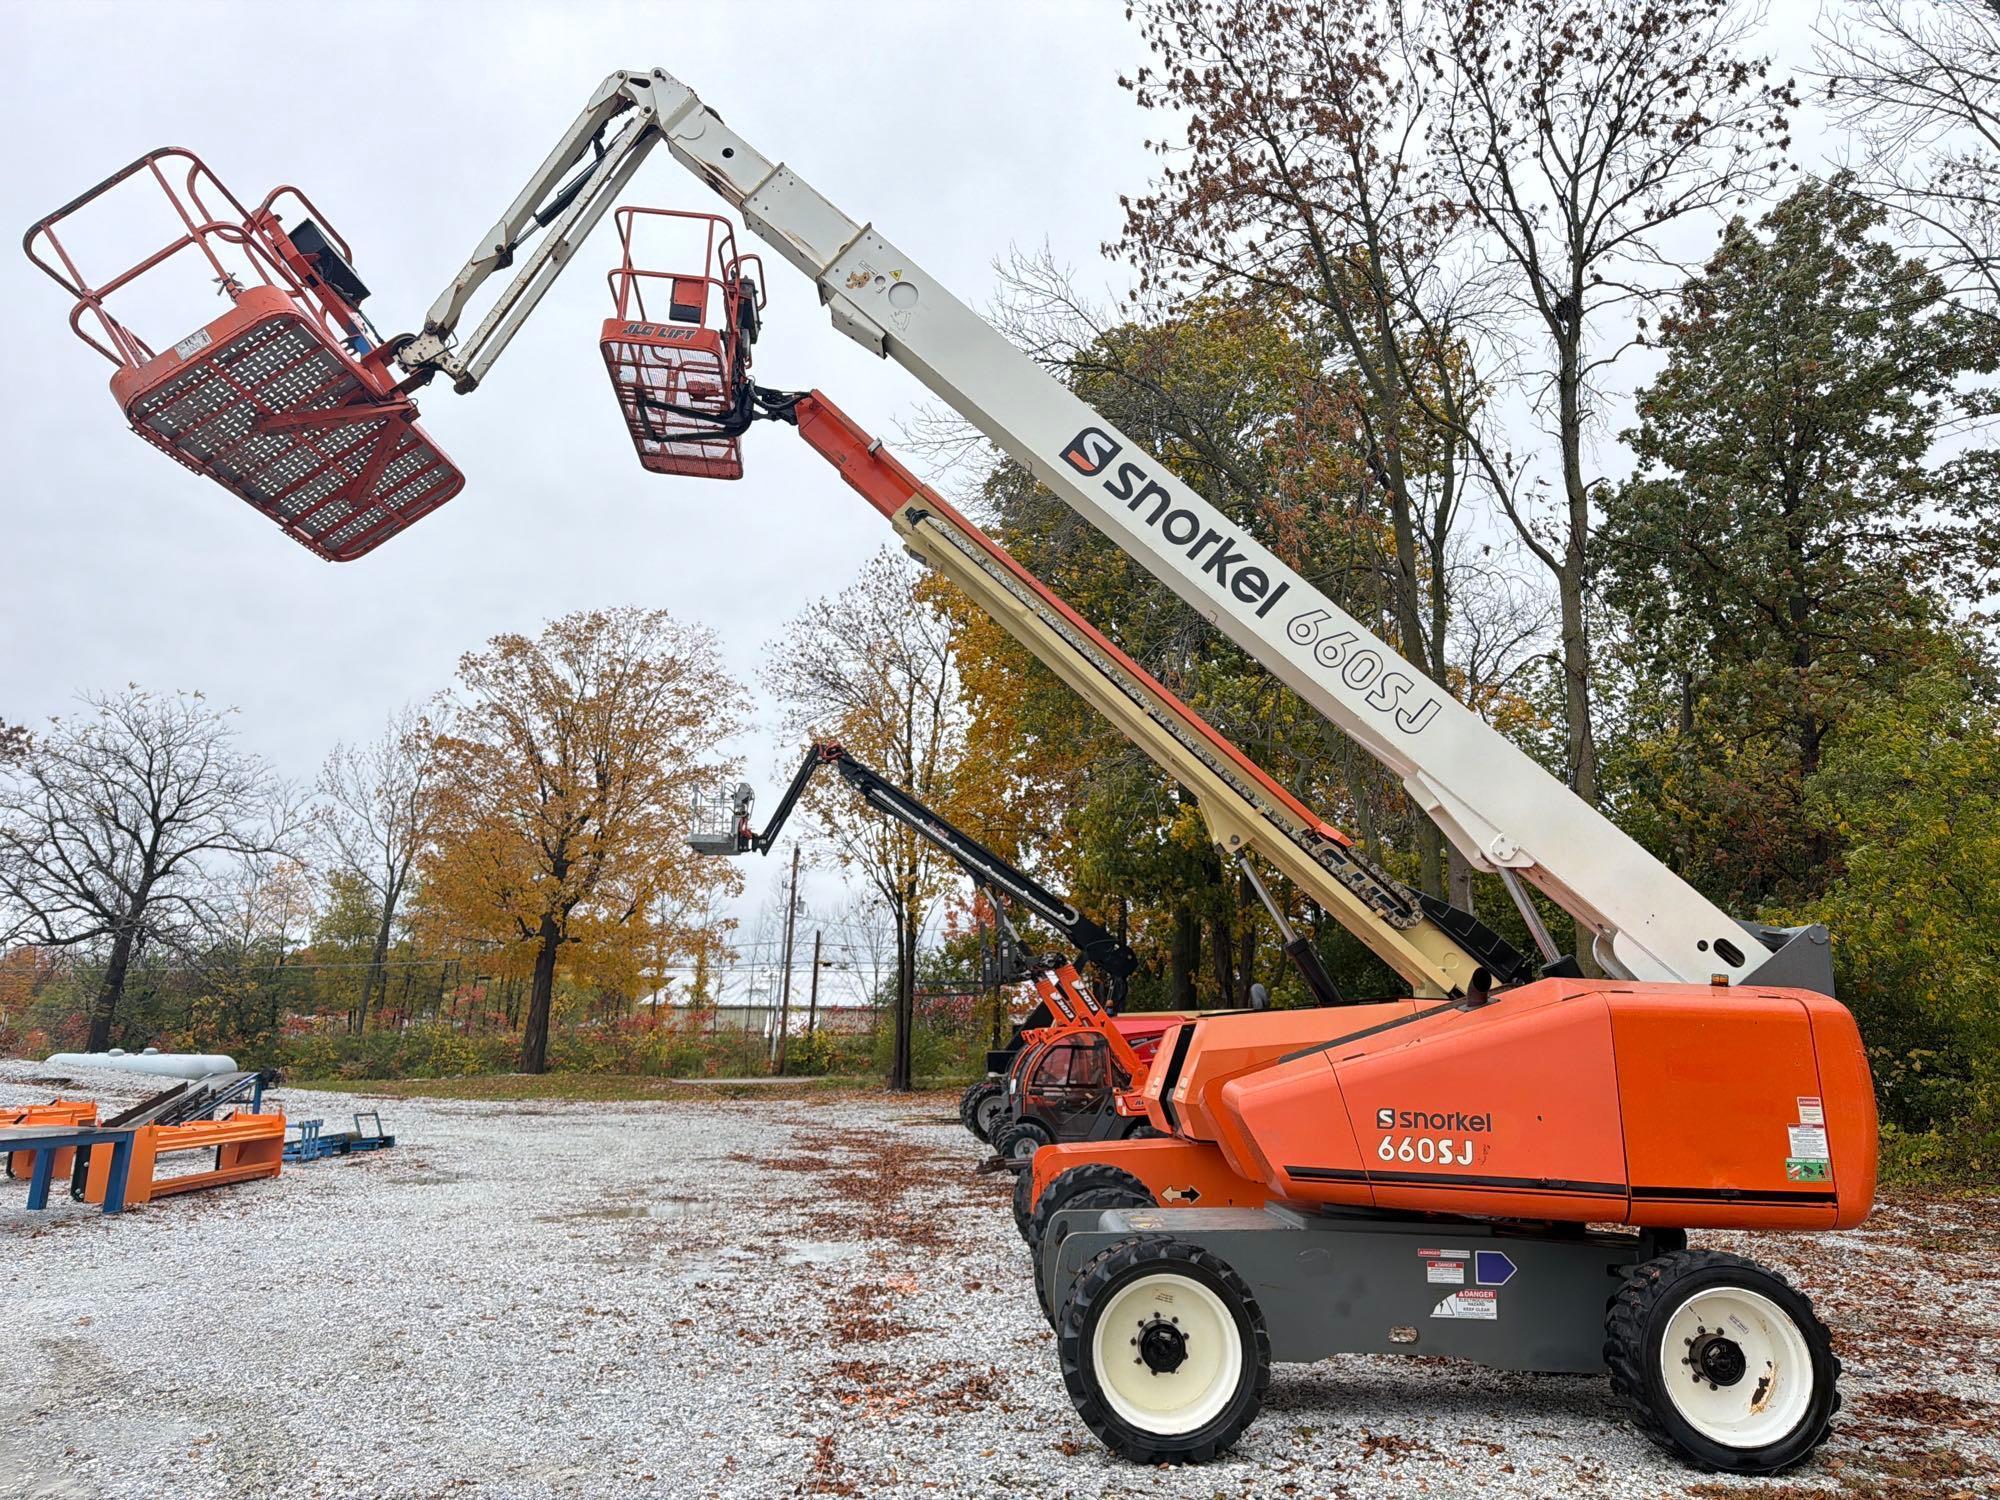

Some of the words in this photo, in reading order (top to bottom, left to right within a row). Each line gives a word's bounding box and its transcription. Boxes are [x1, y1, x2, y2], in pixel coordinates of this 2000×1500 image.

[622, 324, 657, 336] JLG
[658, 327, 697, 341] LIFT
[1103, 463, 1290, 618] snorkel
[1286, 609, 1443, 735] 660SJ
[1400, 1111, 1492, 1132] snorkel
[1377, 1135, 1474, 1166] 660SJ
[1464, 1290, 1494, 1298] DANGER
